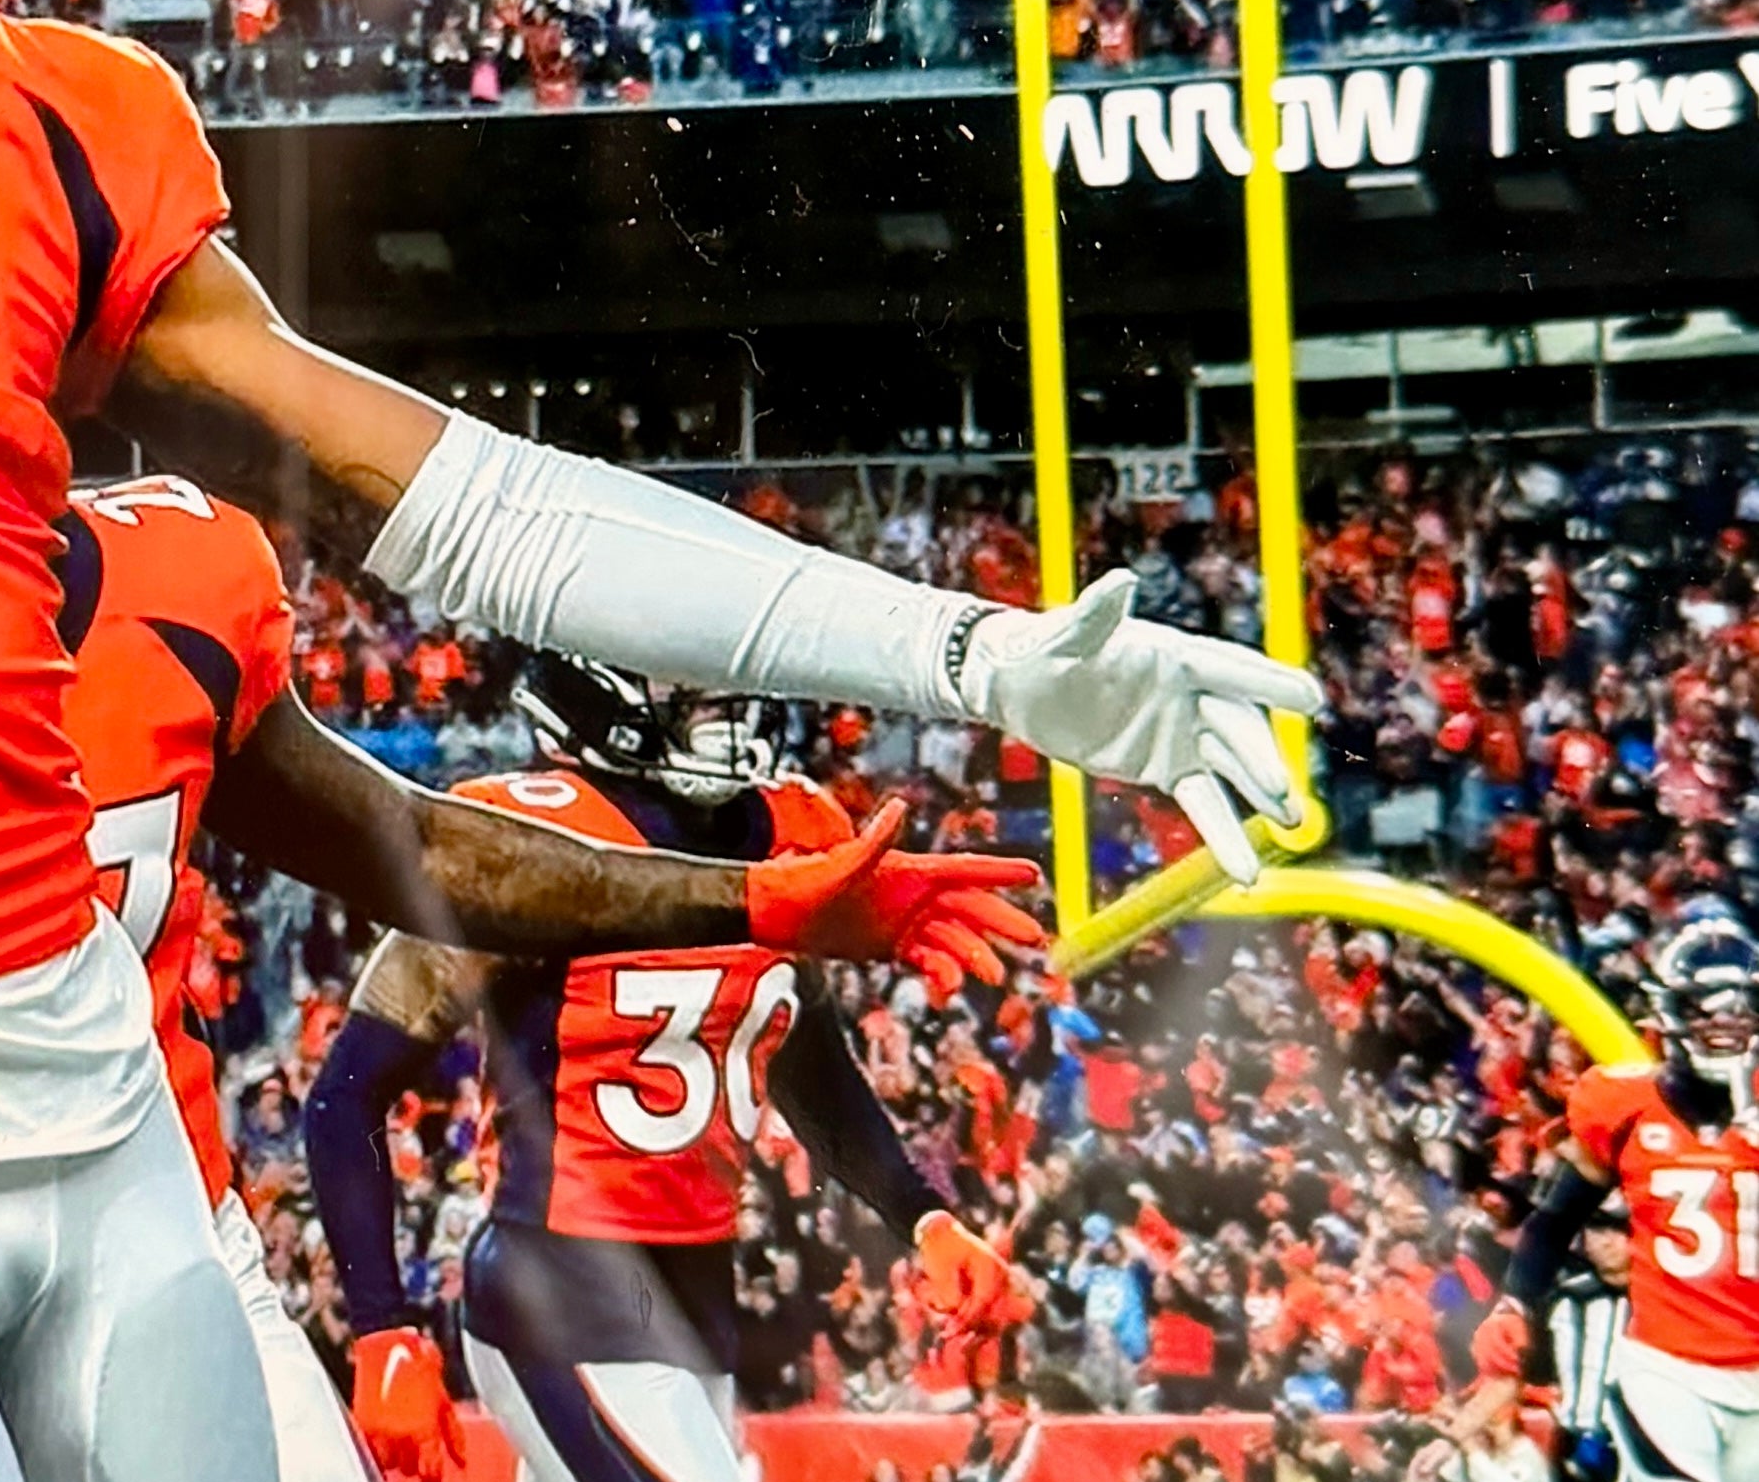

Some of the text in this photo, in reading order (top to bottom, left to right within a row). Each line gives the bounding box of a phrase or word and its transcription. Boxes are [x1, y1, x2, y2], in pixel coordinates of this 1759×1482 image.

[1564, 58, 1740, 139] Five
[592, 957, 800, 1155] 30
[1649, 1168, 1759, 1279] 31
